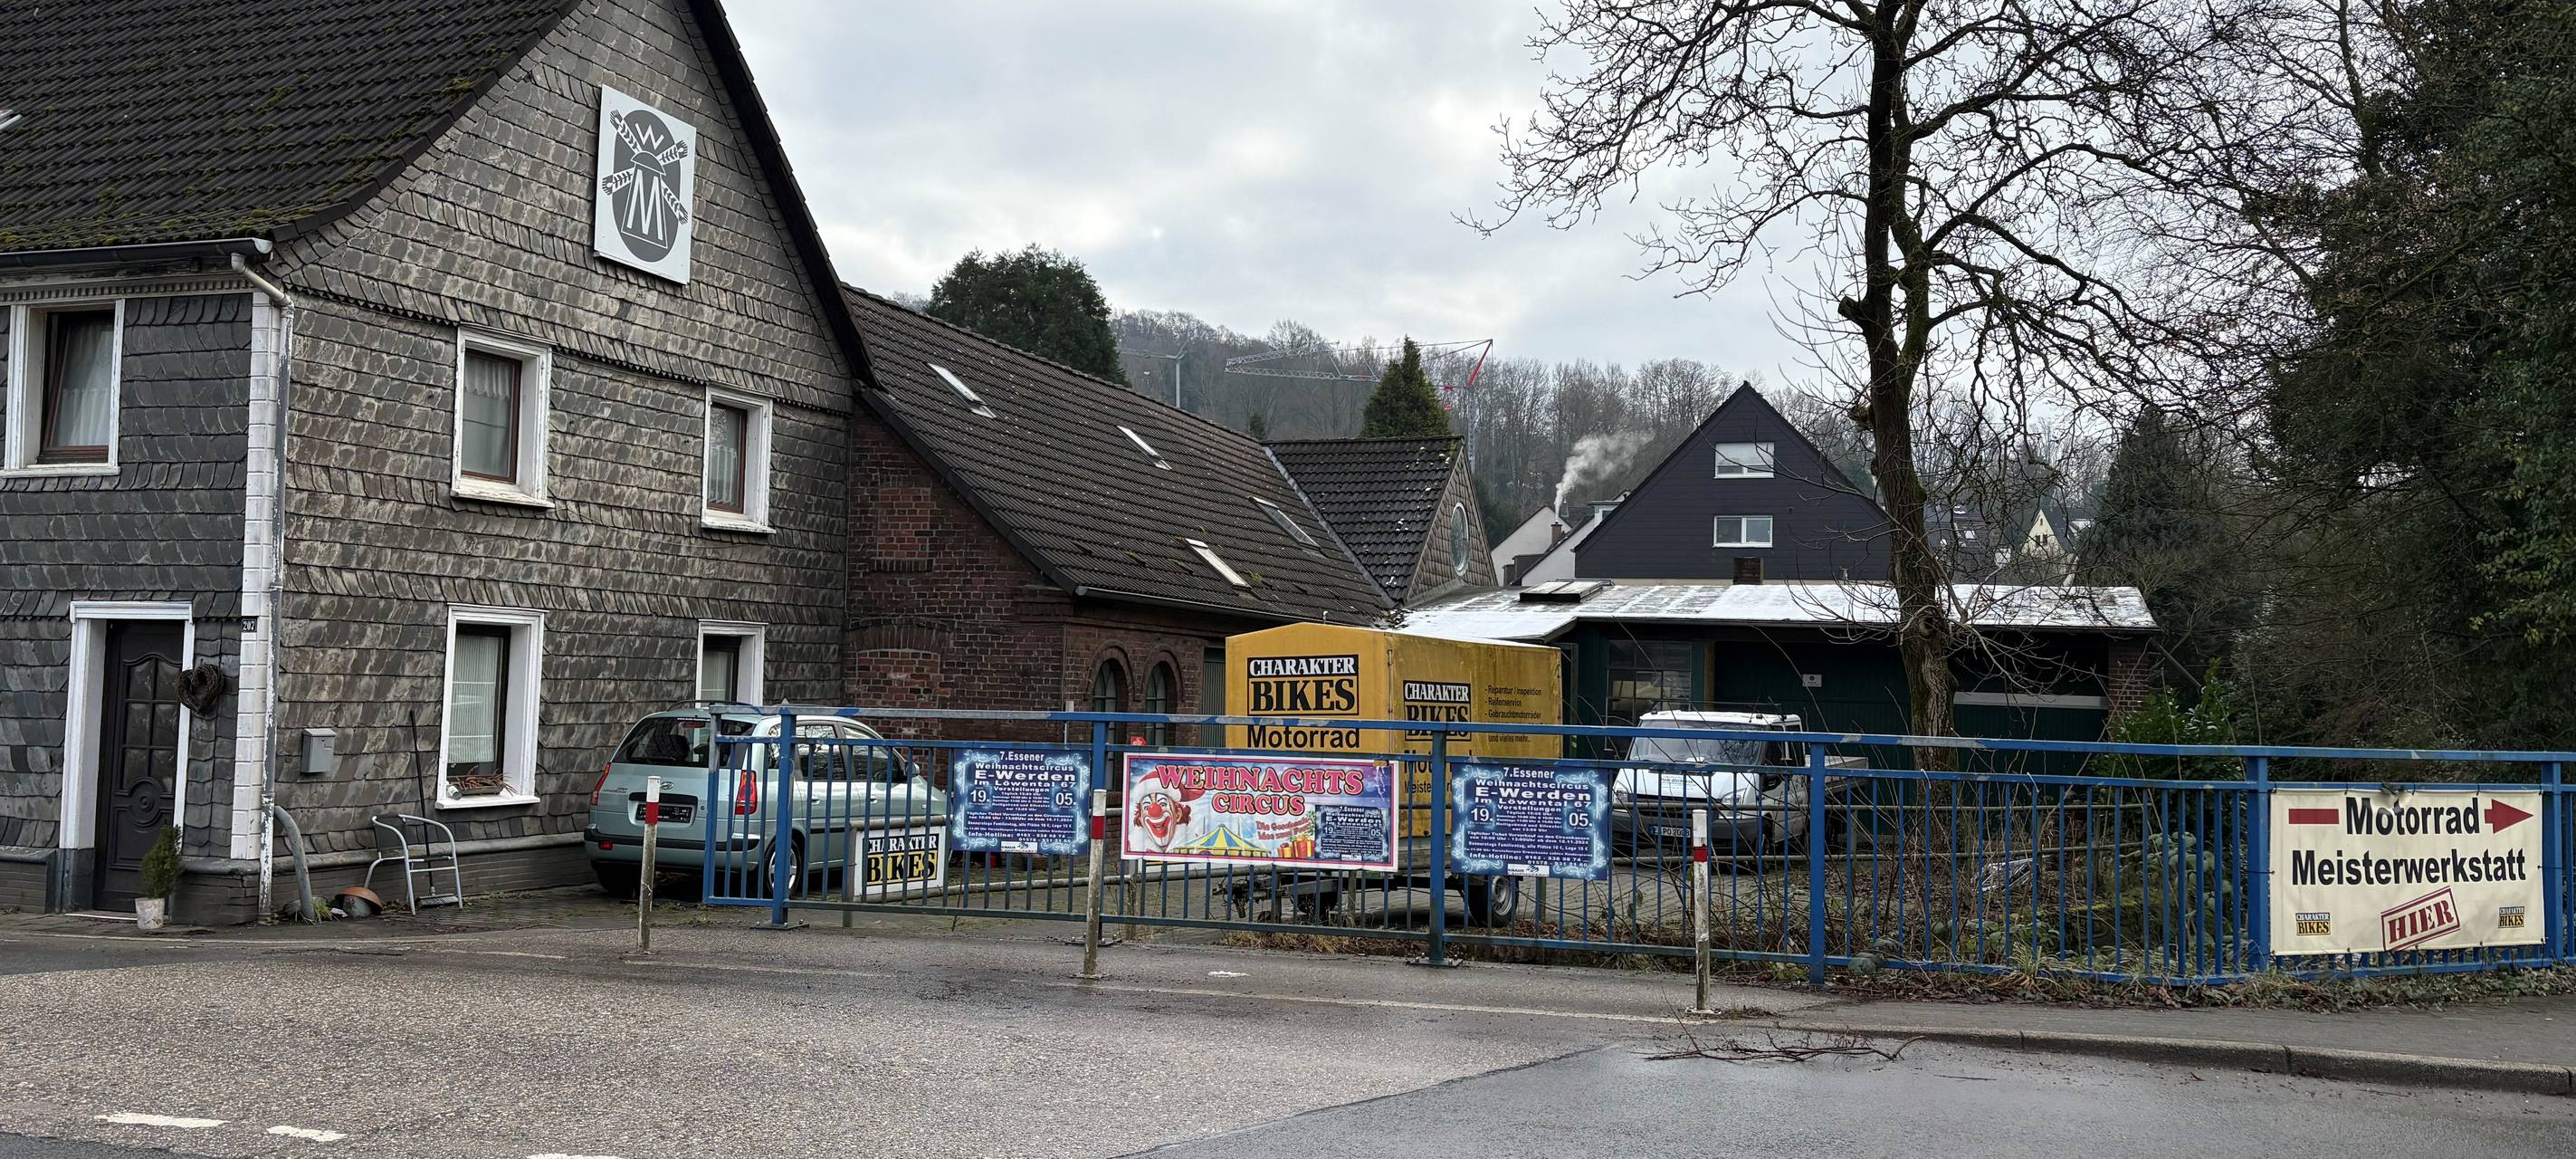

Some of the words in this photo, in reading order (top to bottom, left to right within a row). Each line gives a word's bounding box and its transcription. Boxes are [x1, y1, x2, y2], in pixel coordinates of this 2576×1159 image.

[635, 123, 664, 149] W
[626, 169, 663, 241] M
[243, 620, 255, 630] 207
[1249, 657, 1355, 676] CHARAKTER
[1251, 679, 1355, 711] BIKES
[1405, 683, 1469, 702] CHARAKTER
[1488, 685, 1513, 694] Reparatur
[1517, 687, 1542, 696] Inspektion
[1488, 697, 1522, 706] Reifenservice
[1406, 705, 1468, 736] BIKES
[1247, 724, 1360, 748] Motorrad
[975, 762, 1073, 771] Weihnachtscircus
[1503, 767, 1555, 779] 7.Essener
[976, 771, 1075, 781] E-Werden
[1156, 765, 1363, 795] WEIHNACHTS
[1475, 779, 1589, 790] Weihnachtscircus
[970, 790, 989, 802] 19.
[1055, 793, 1076, 806] 05.
[1476, 787, 1590, 800] E-Werden
[1212, 792, 1305, 815] CIRCUS
[1499, 798, 1568, 807] Löwental
[1471, 809, 1493, 821] 19.
[1569, 813, 1593, 827] 05.
[2346, 797, 2480, 835] Motorrad
[867, 836, 937, 853] HRAKTR
[867, 853, 935, 882] BKES
[2292, 848, 2526, 886] Meisterwerkstatt
[2388, 899, 2455, 944] HIER
[2500, 915, 2524, 926] BIKES
[2297, 922, 2329, 934] BIKES
